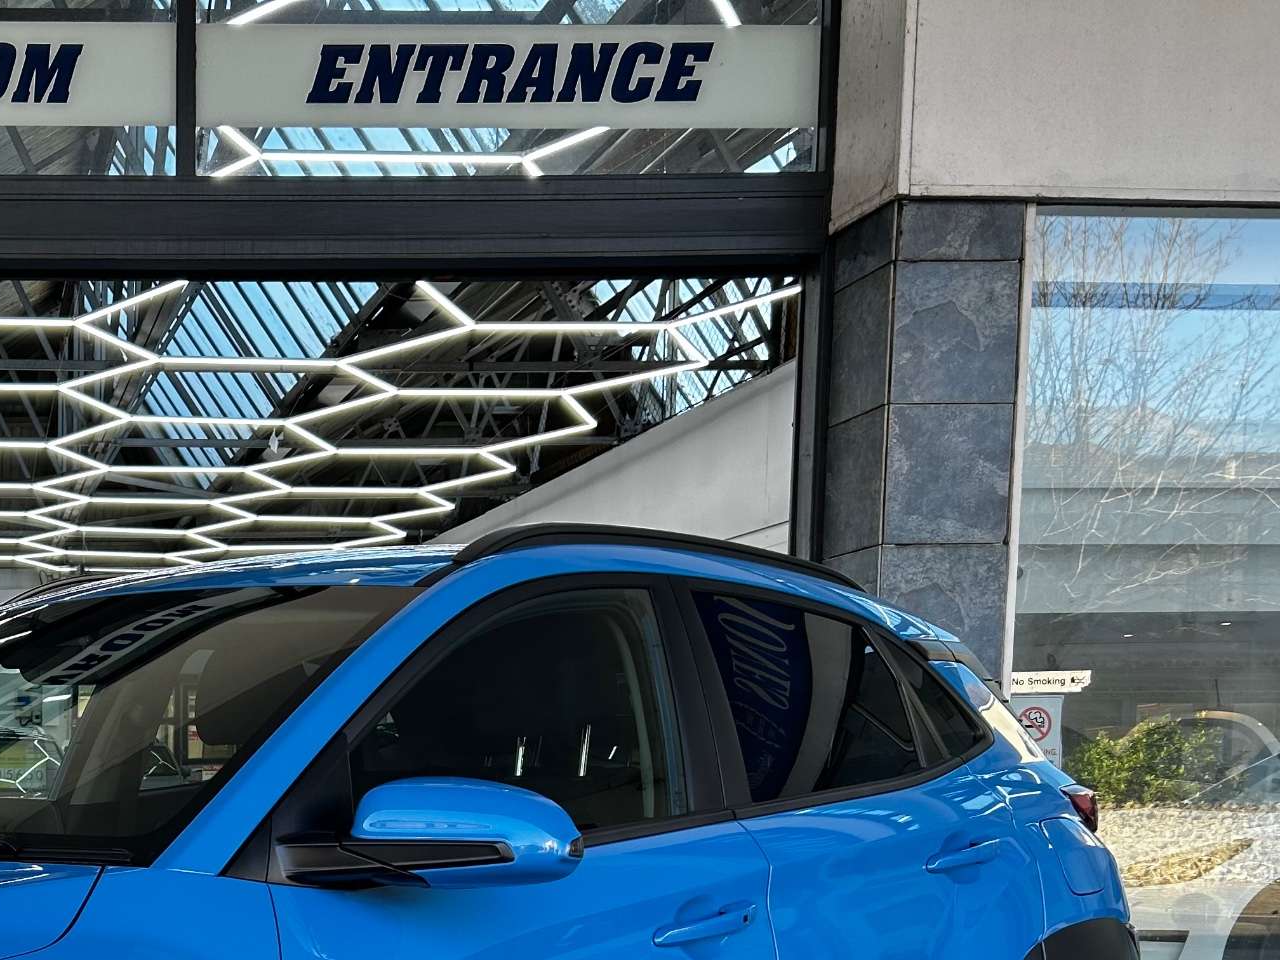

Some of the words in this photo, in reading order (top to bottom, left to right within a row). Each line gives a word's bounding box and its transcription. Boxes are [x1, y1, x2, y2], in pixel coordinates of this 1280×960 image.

[305, 41, 714, 104] ENTRANCE
[1012, 678, 1025, 686] No
[1027, 677, 1066, 687] Smoking
